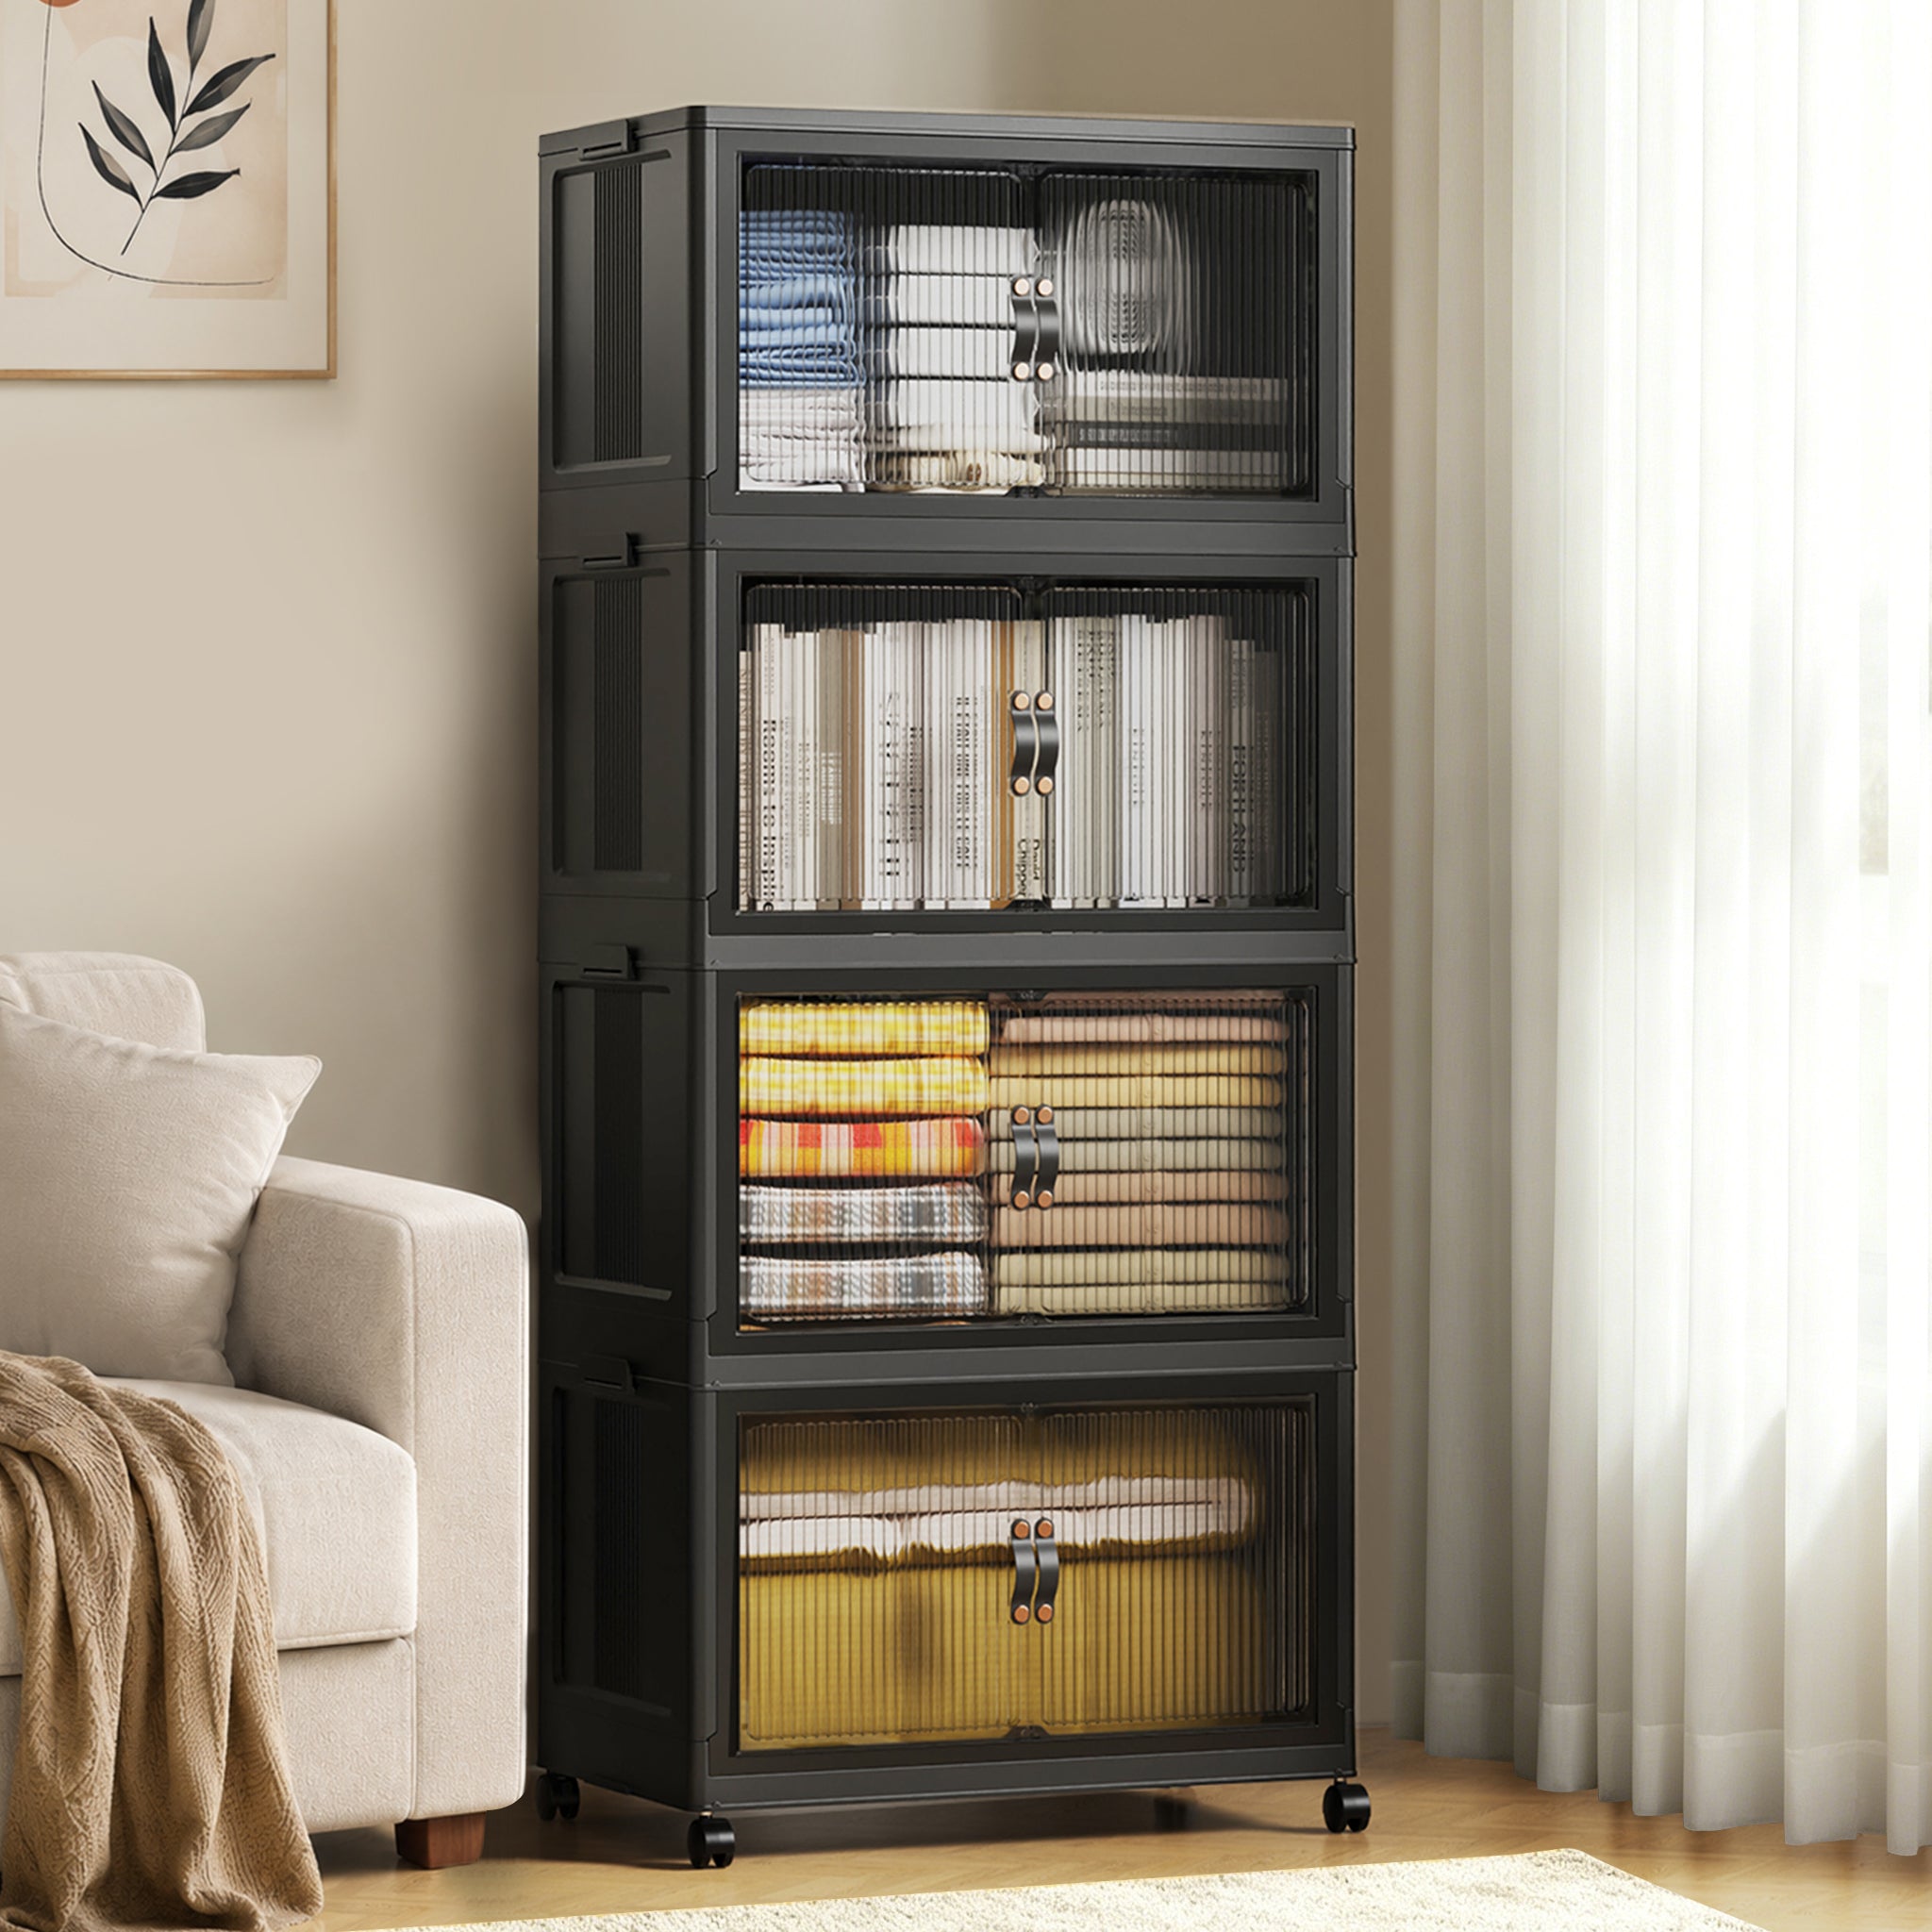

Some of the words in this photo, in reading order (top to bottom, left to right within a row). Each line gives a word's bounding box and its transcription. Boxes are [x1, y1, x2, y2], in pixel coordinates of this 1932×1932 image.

[763, 719, 776, 797] Rooms
[763, 805, 776, 827] to
[1232, 745, 1246, 873] PORTLAND
[761, 836, 776, 911] Inspire
